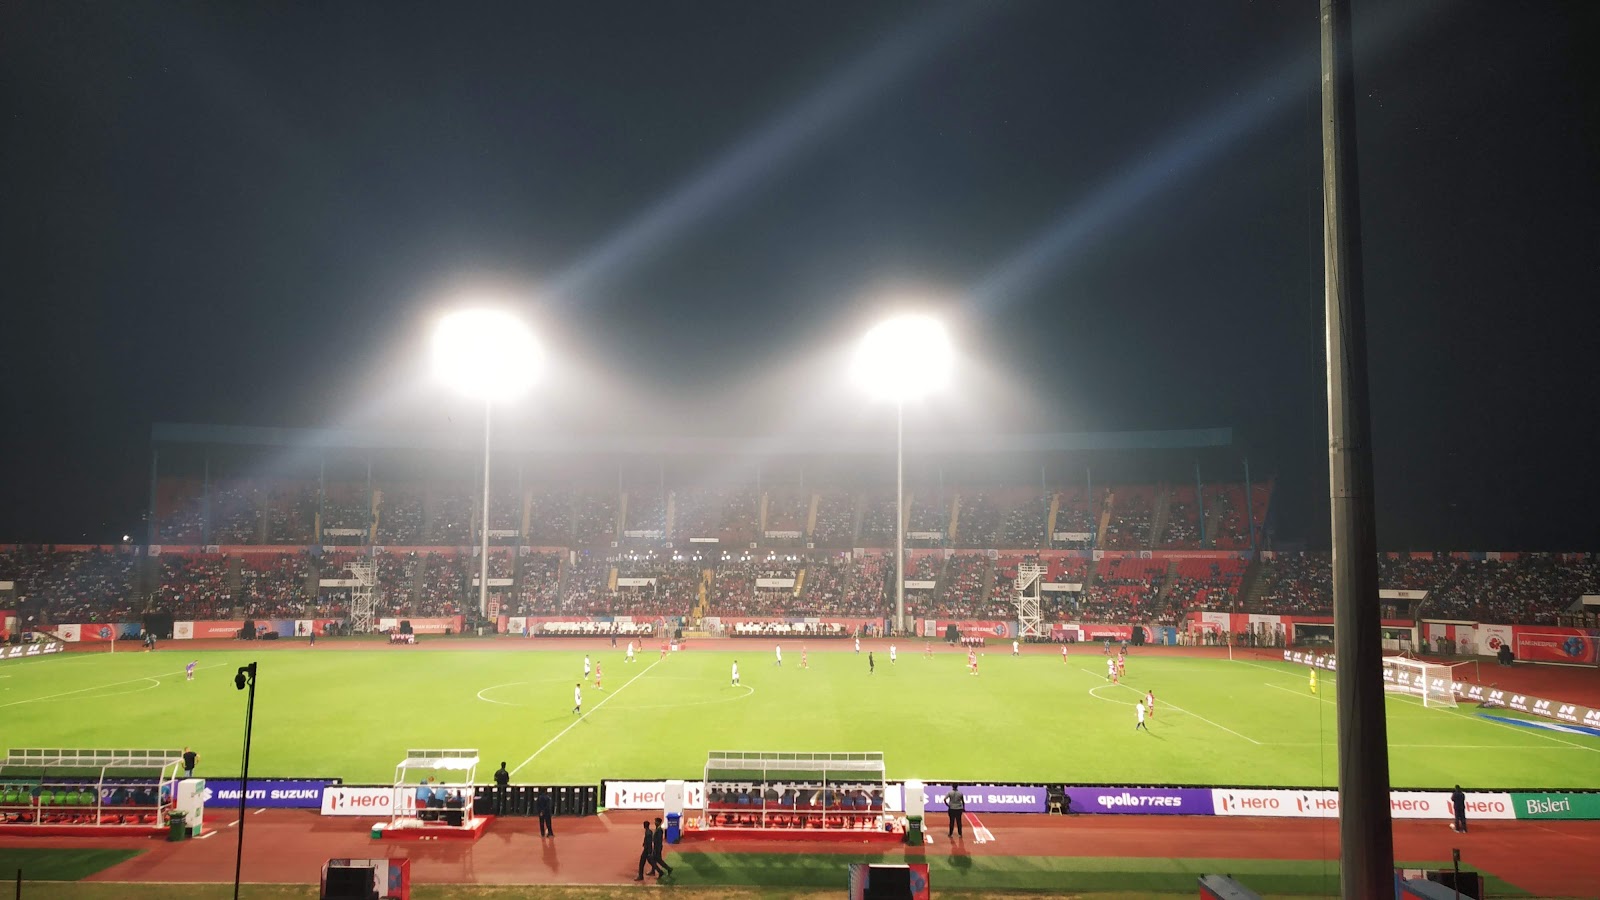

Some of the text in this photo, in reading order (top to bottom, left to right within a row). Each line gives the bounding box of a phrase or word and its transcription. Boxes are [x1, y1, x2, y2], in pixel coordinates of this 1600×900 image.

[270, 790, 319, 799] SUZUKI
[988, 794, 1036, 804] SUZUKI
[1526, 797, 1570, 815] Bisleri
